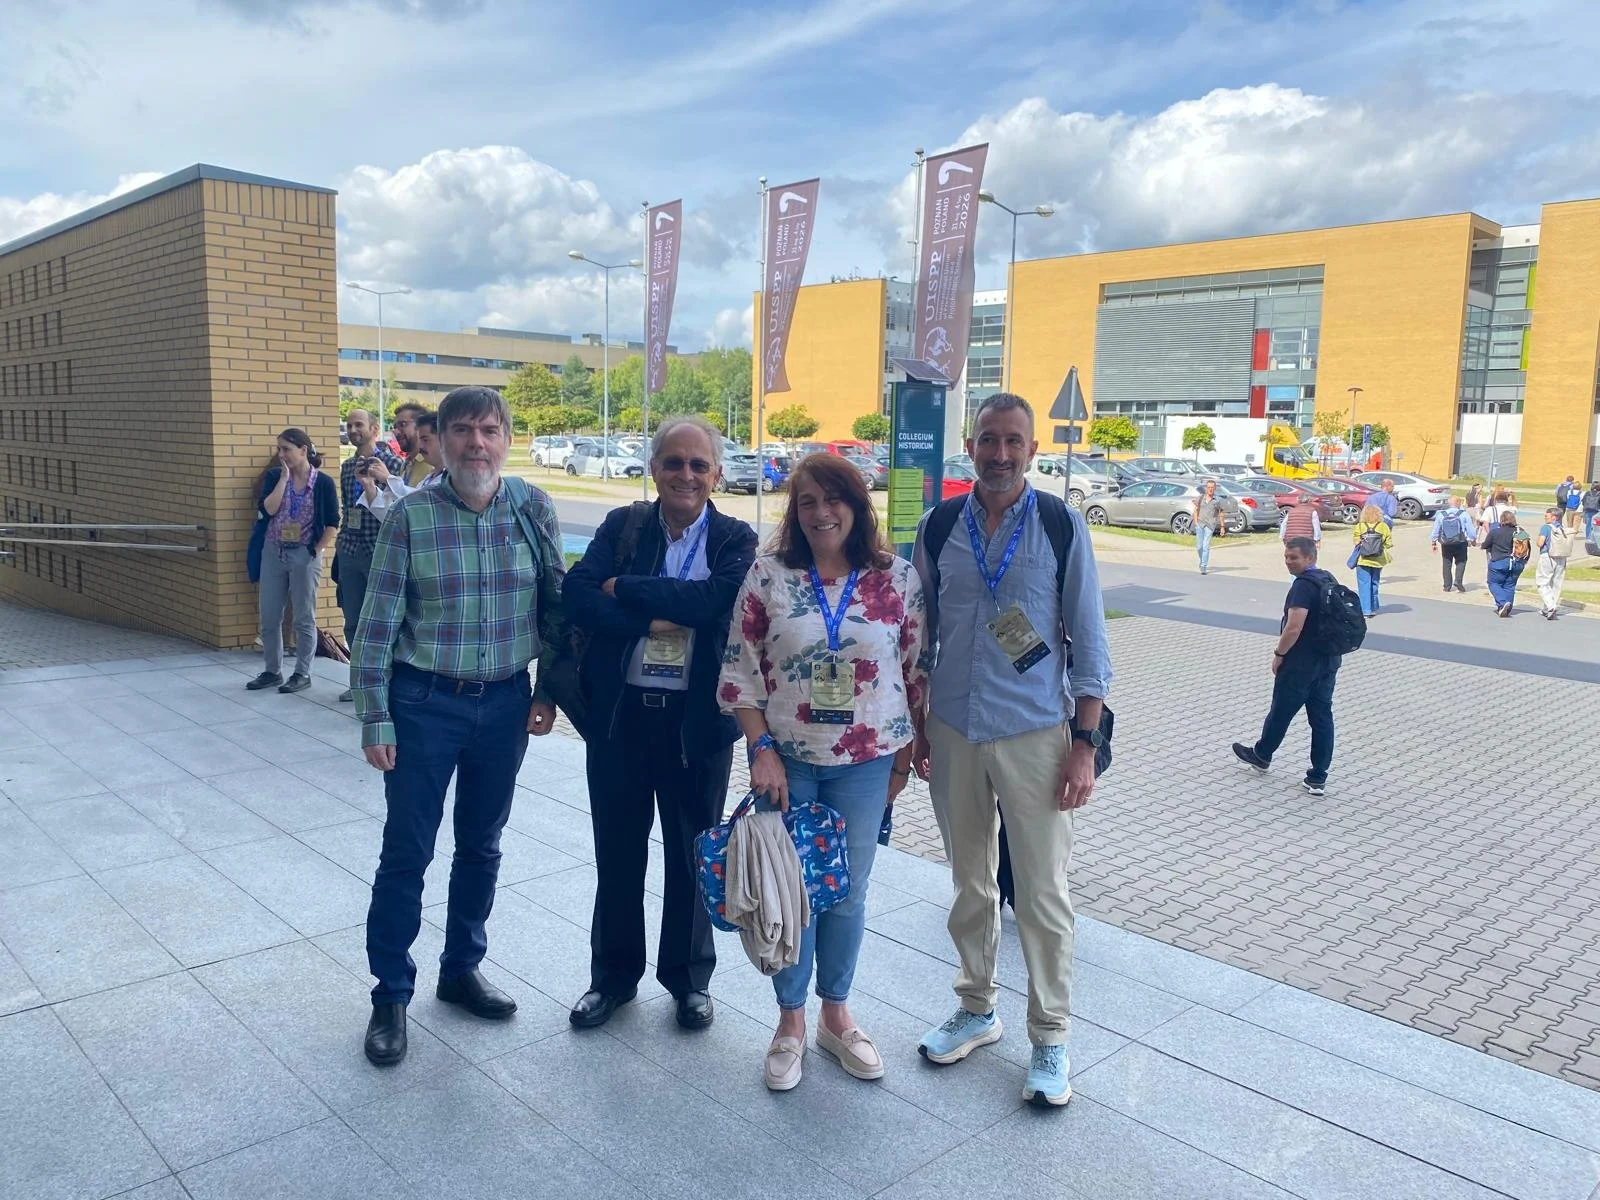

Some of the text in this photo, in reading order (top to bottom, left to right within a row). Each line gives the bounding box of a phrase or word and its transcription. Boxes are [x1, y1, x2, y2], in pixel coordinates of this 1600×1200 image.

[941, 197, 950, 233] POLAND
[959, 192, 971, 229] 2026
[769, 270, 782, 335] UISPP
[925, 251, 942, 324] UISPP
[651, 280, 660, 338] UISPP
[898, 432, 934, 441] COLLEGIUM
[898, 441, 934, 450] HISTORICUM
